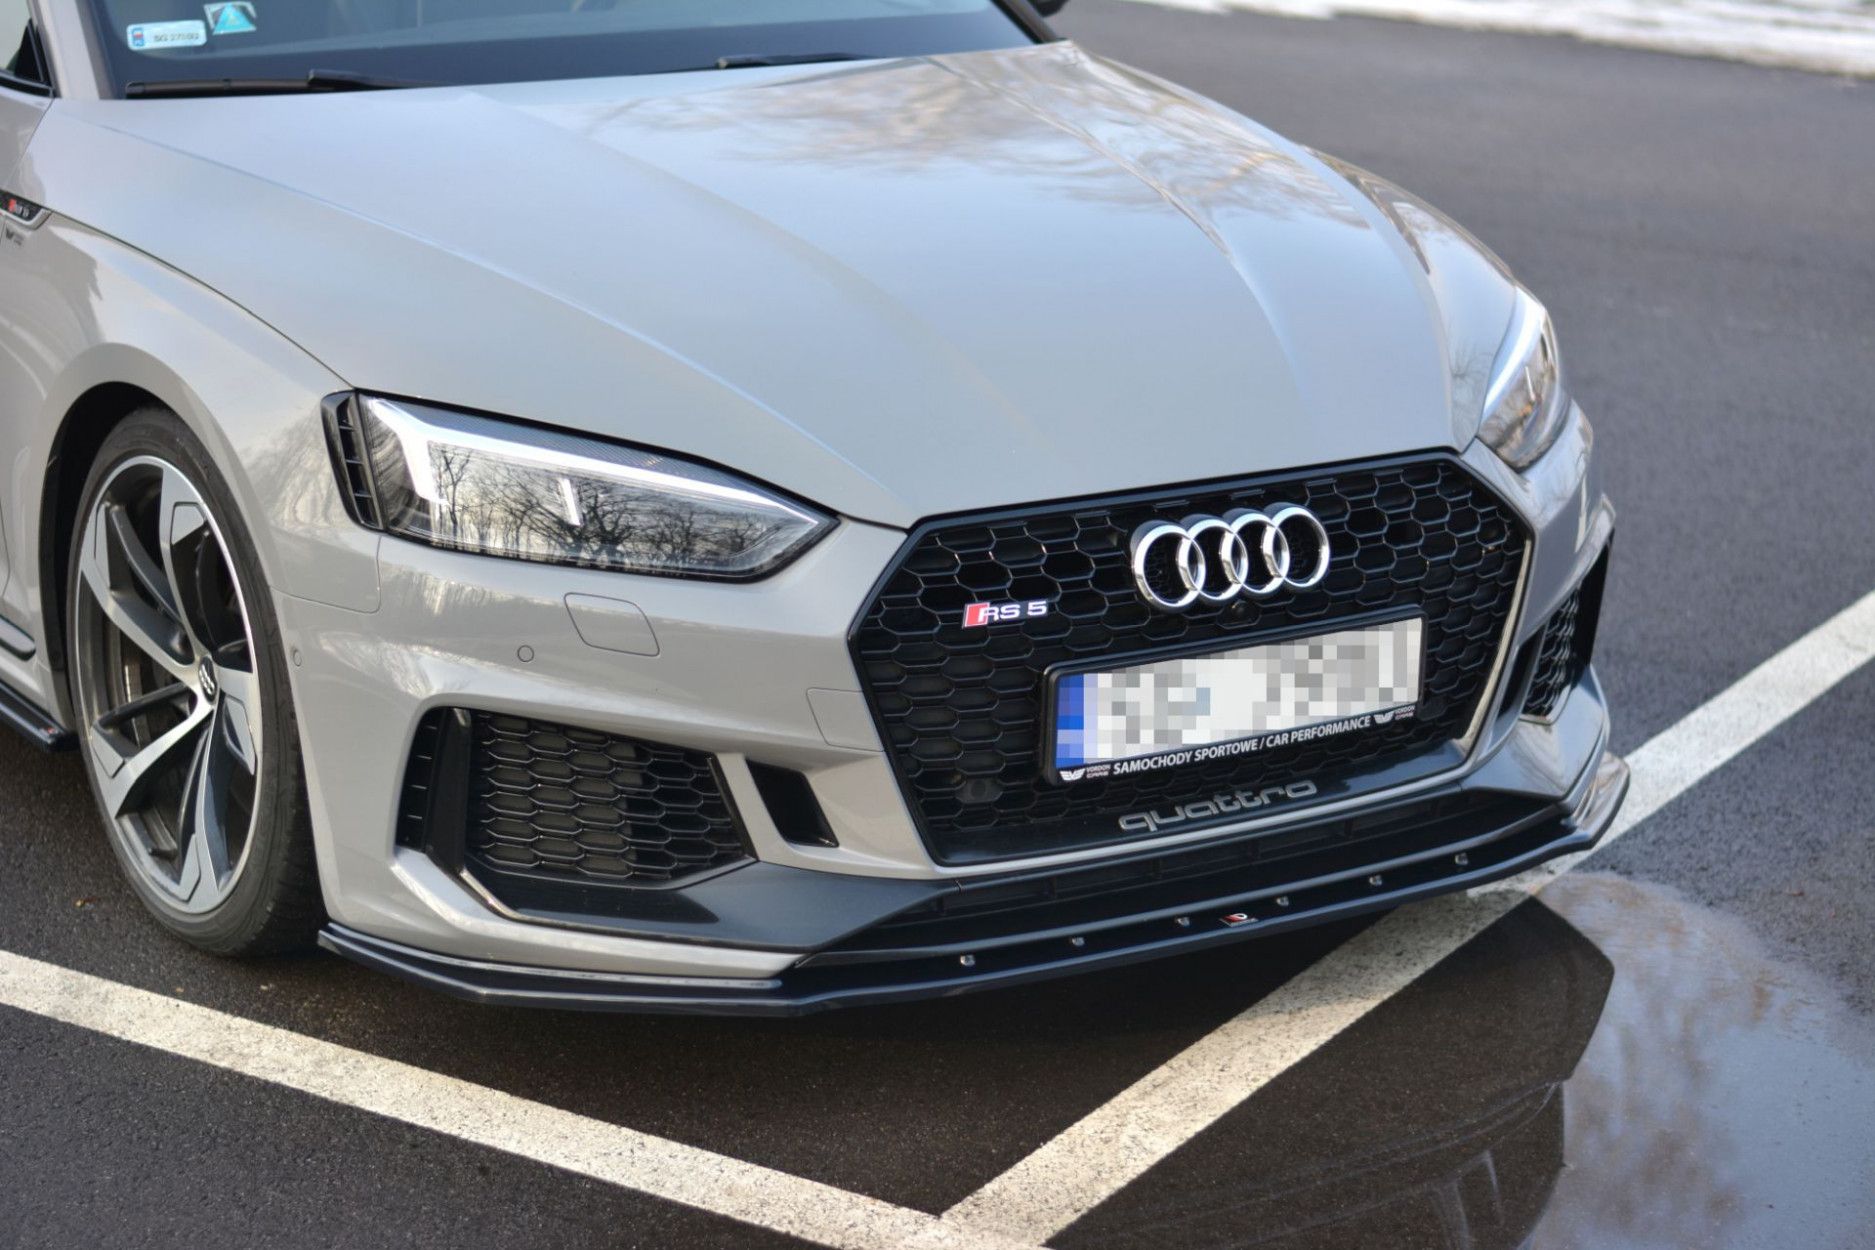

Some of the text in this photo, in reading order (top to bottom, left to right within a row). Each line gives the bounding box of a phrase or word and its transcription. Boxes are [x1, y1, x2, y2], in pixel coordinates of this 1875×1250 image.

[977, 600, 1048, 623] RS 5
[1113, 751, 1193, 775] SAMOCHODY
[1194, 738, 1258, 762] SPORTOWE
[1266, 732, 1290, 748] CAR
[1290, 714, 1371, 743] PERFORMANCE
[1118, 780, 1317, 832] quattro
